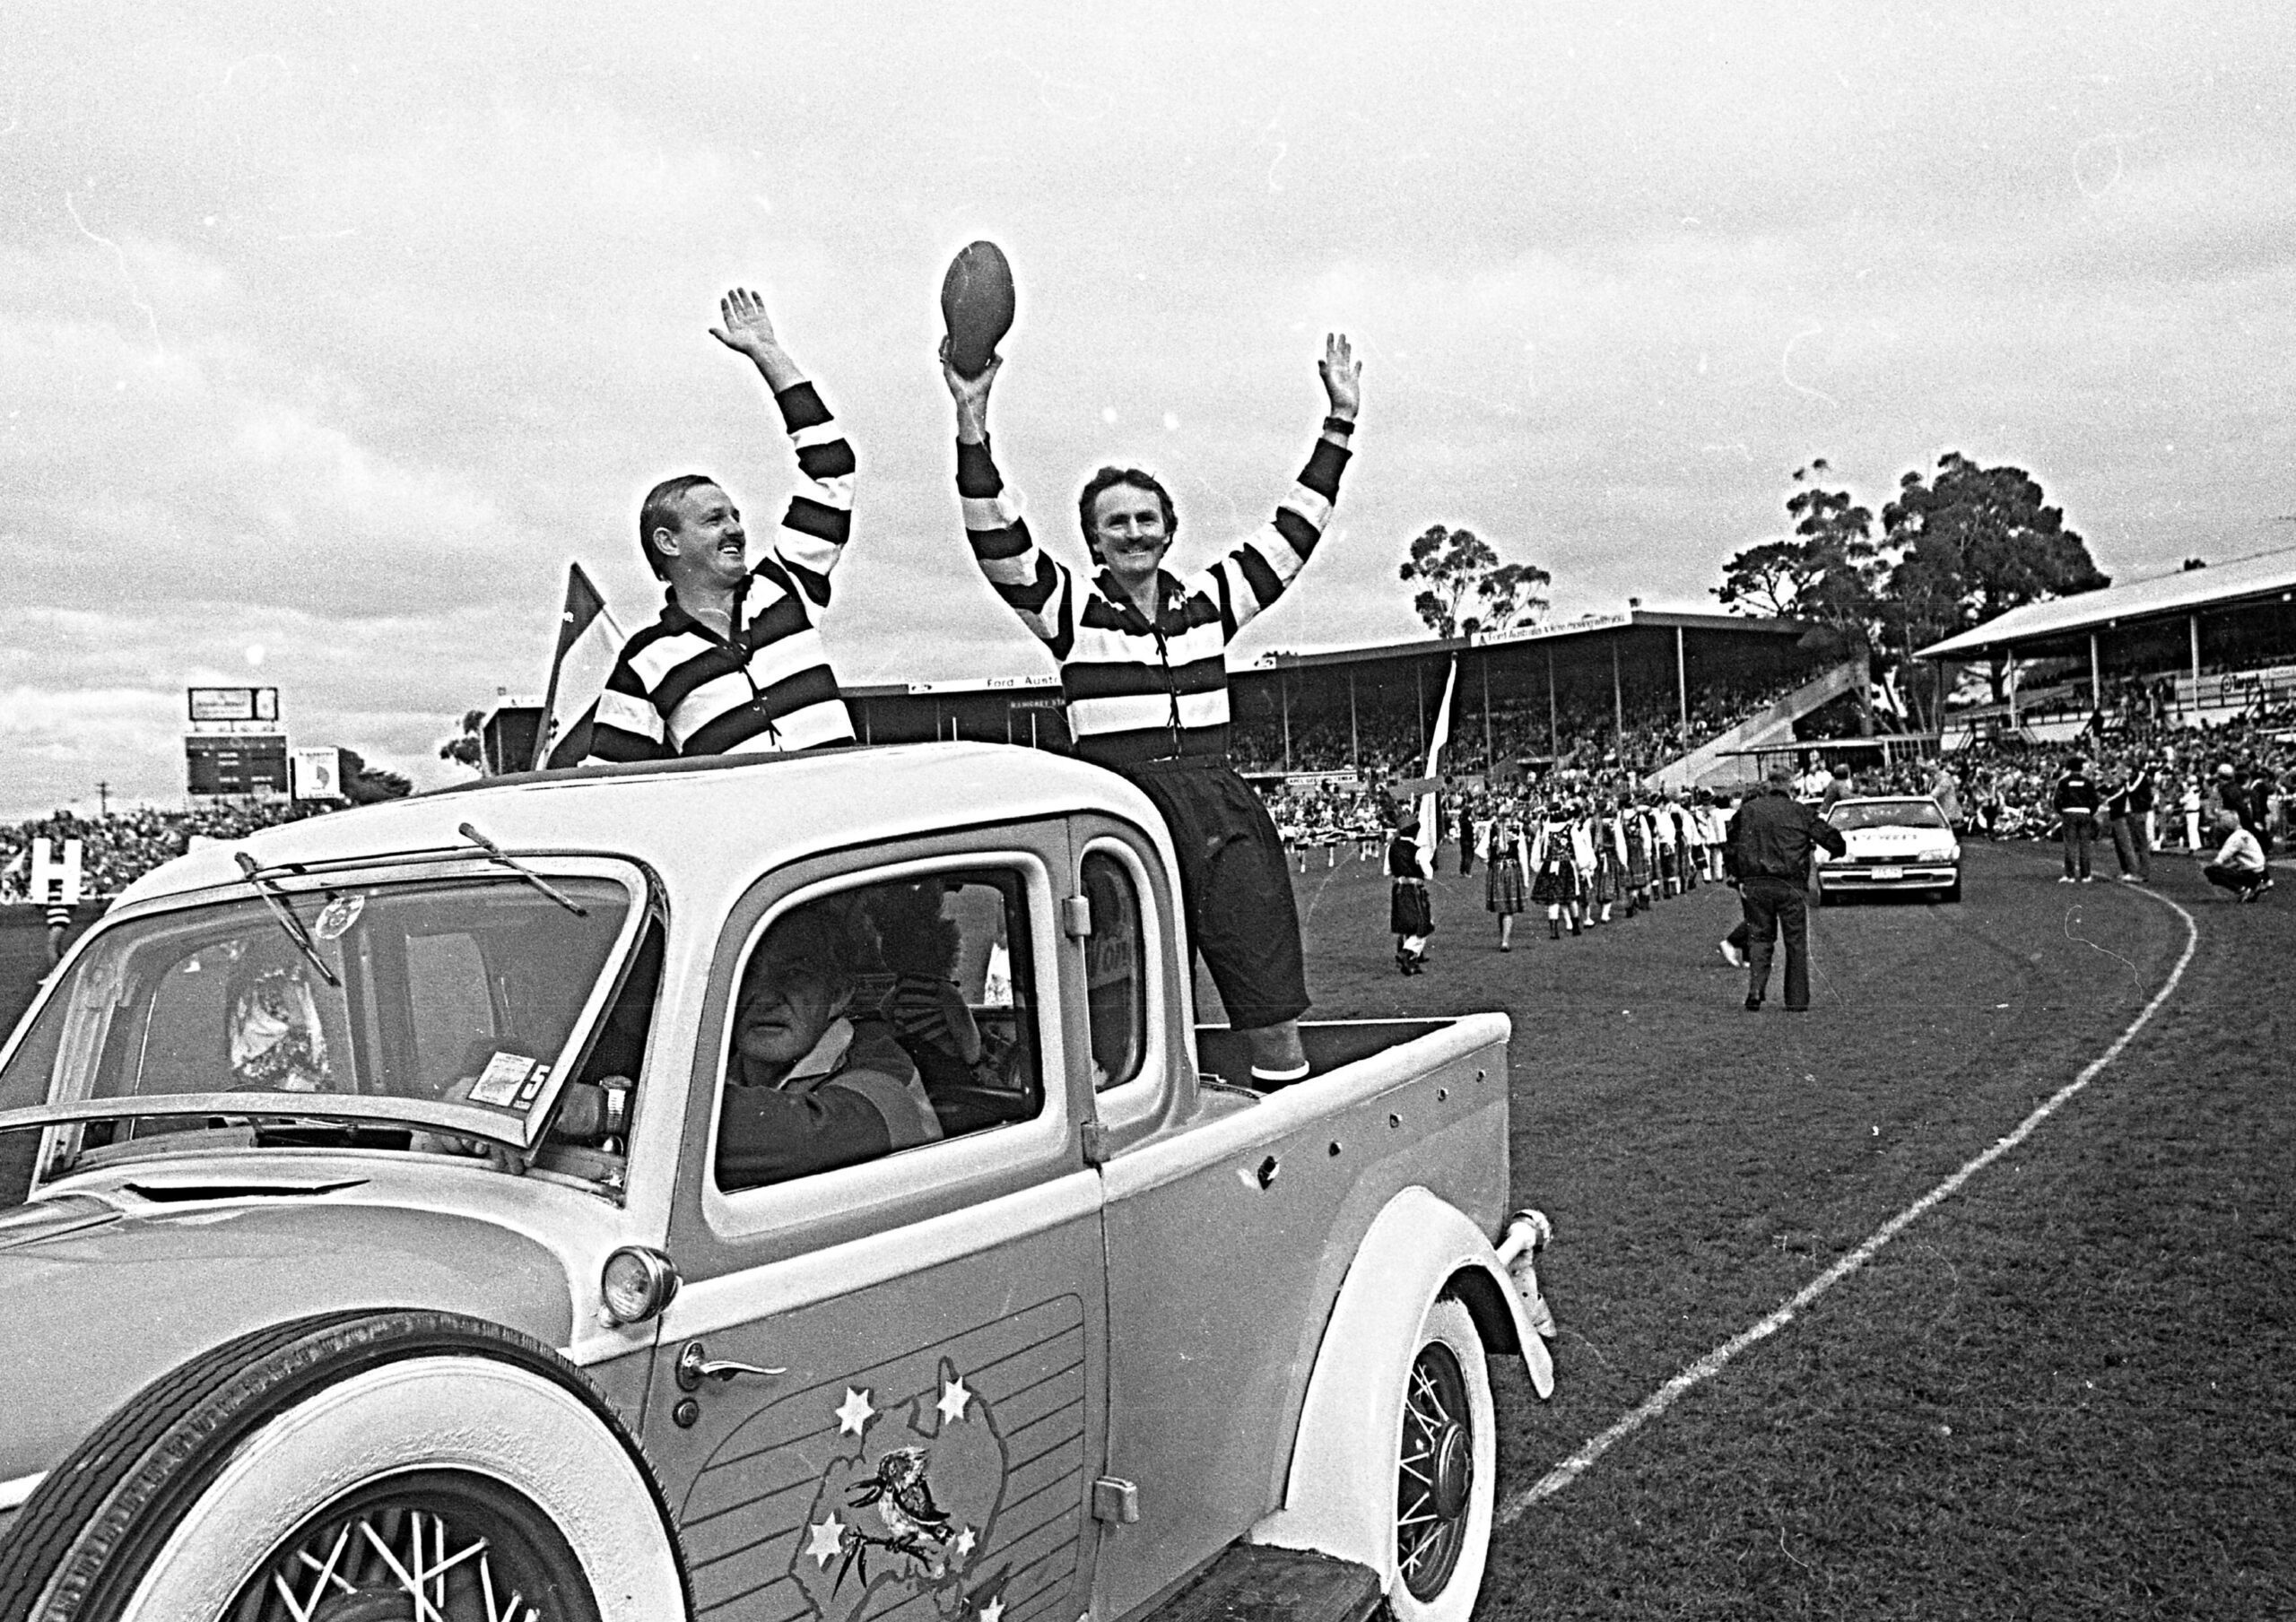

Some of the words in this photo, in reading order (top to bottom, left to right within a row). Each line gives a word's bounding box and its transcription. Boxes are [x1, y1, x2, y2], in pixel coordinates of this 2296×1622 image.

[987, 679, 1014, 688] Ford
[2232, 673, 2260, 690] Target
[30, 837, 83, 905] H
[521, 1064, 551, 1100] 5
